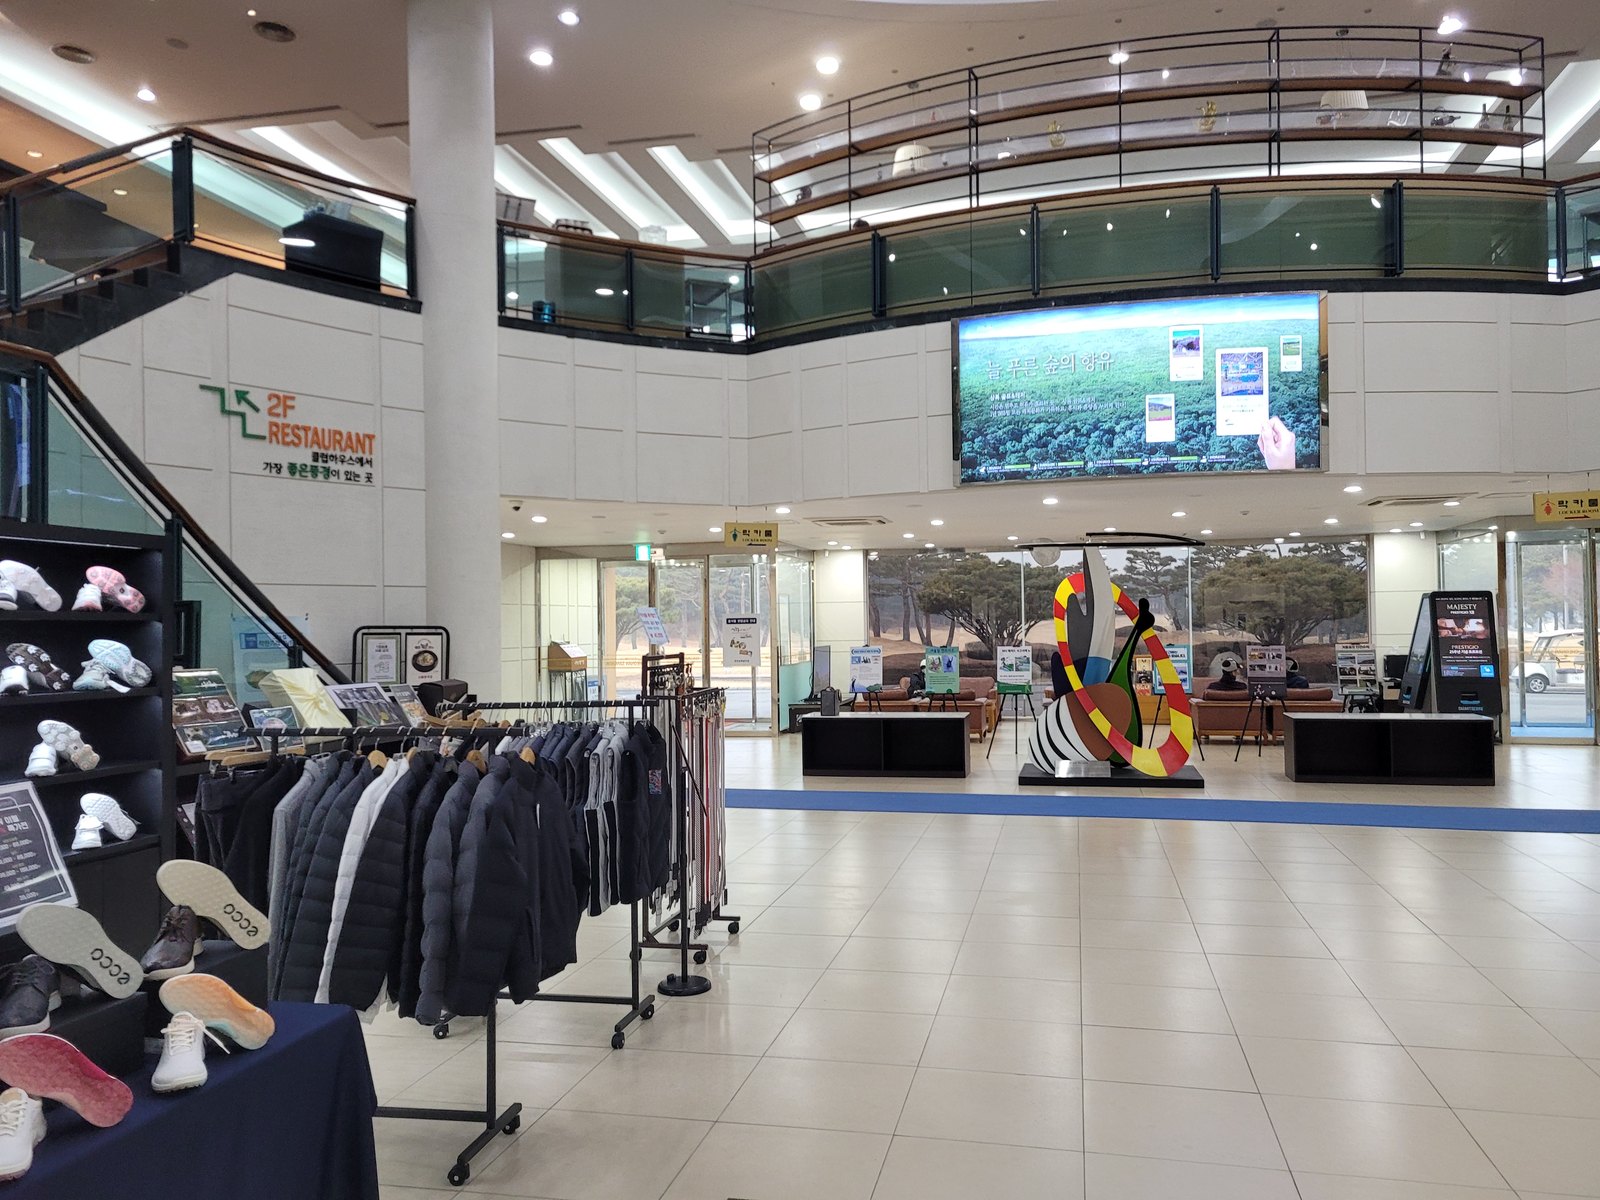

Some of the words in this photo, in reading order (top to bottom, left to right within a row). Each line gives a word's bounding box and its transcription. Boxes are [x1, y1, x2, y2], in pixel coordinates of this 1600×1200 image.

[985, 360, 1002, 380] 늘
[1006, 357, 1039, 378] 푸른
[1043, 353, 1075, 375] 숲의
[1080, 351, 1115, 372] 향유
[267, 392, 296, 418] 2F
[267, 421, 376, 455] RESTAURANT
[262, 461, 283, 475] 가장
[343, 470, 361, 483] 있는
[364, 472, 373, 484] 곳
[311, 451, 373, 468] 클럽하우스에서
[222, 903, 259, 938] ecco
[90, 948, 131, 986] ecco
